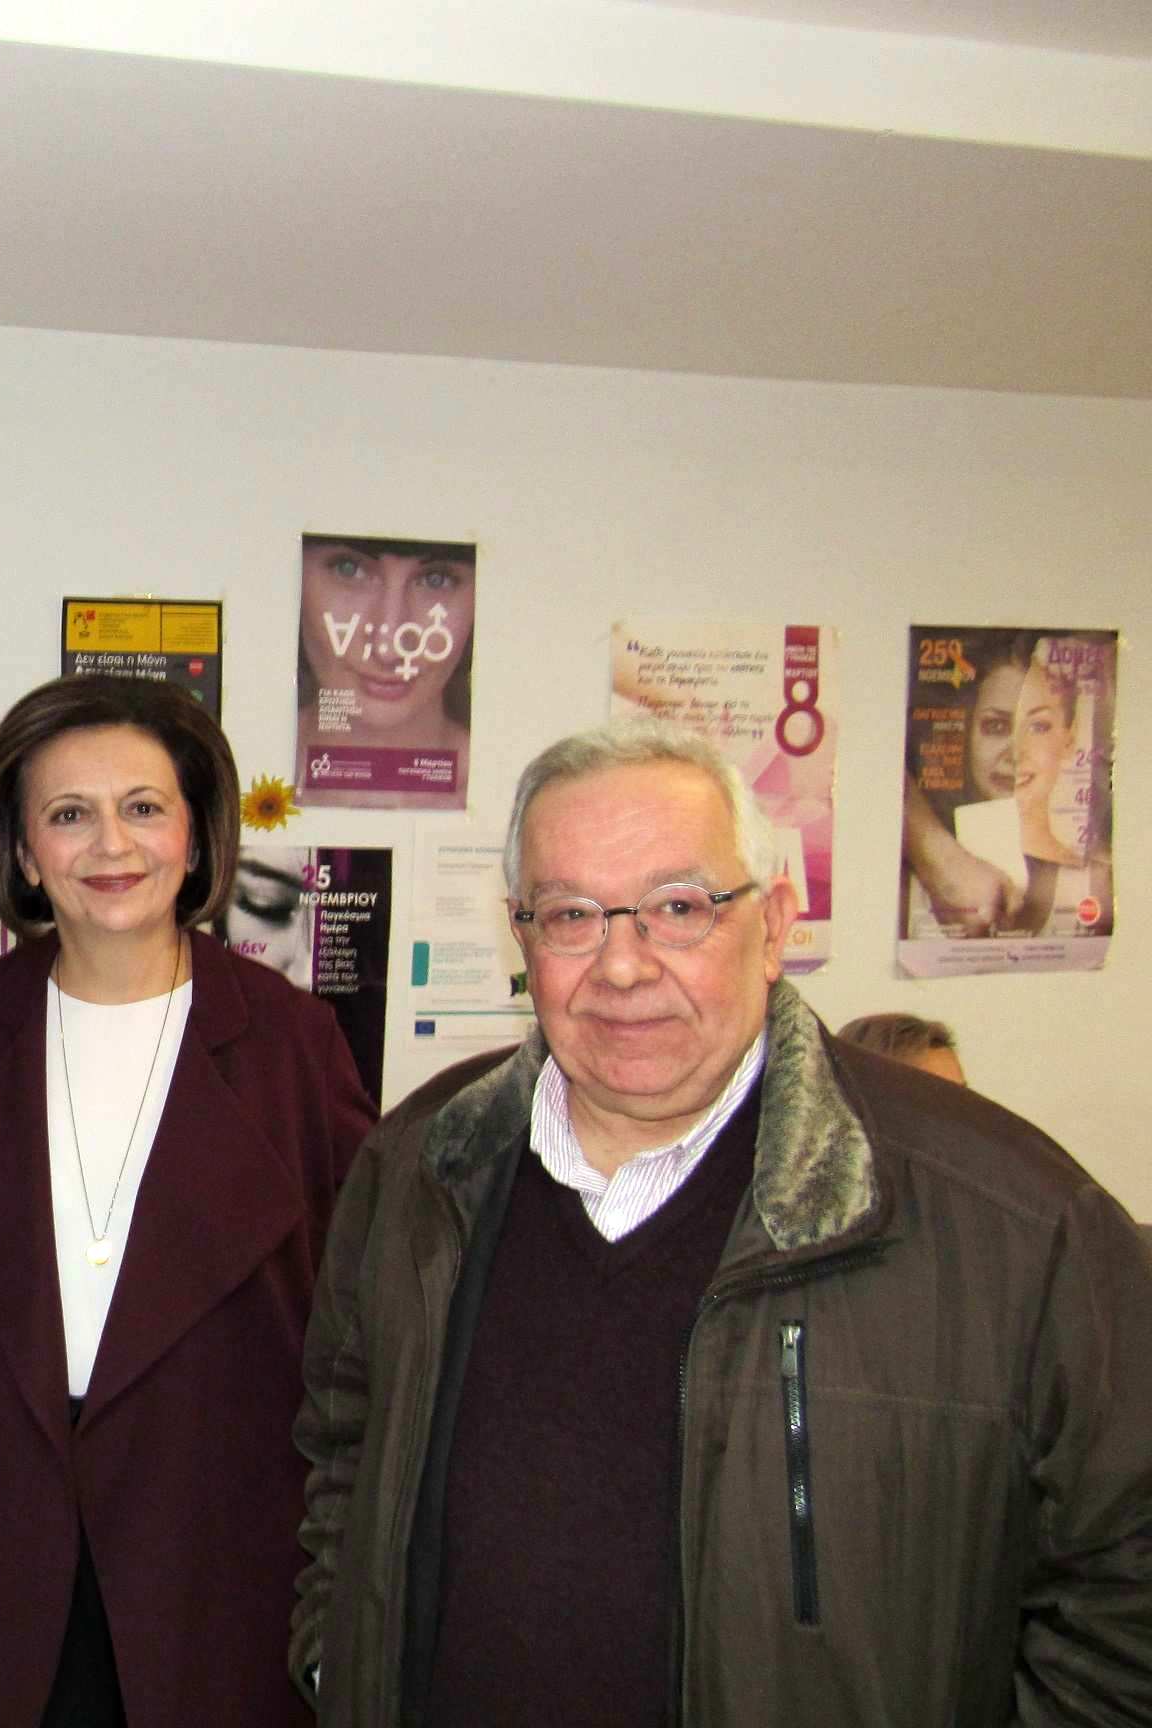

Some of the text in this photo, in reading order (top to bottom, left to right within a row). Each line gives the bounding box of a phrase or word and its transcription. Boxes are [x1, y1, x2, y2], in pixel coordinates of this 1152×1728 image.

[75, 652, 167, 667] Δεν είσαι η Μόνη
[302, 863, 332, 890] 25
[299, 892, 378, 908] ΝΟΕΜΒΡΙΟΥ
[320, 910, 372, 924] Παγκόσμια
[319, 923, 349, 936] Ημέρα
